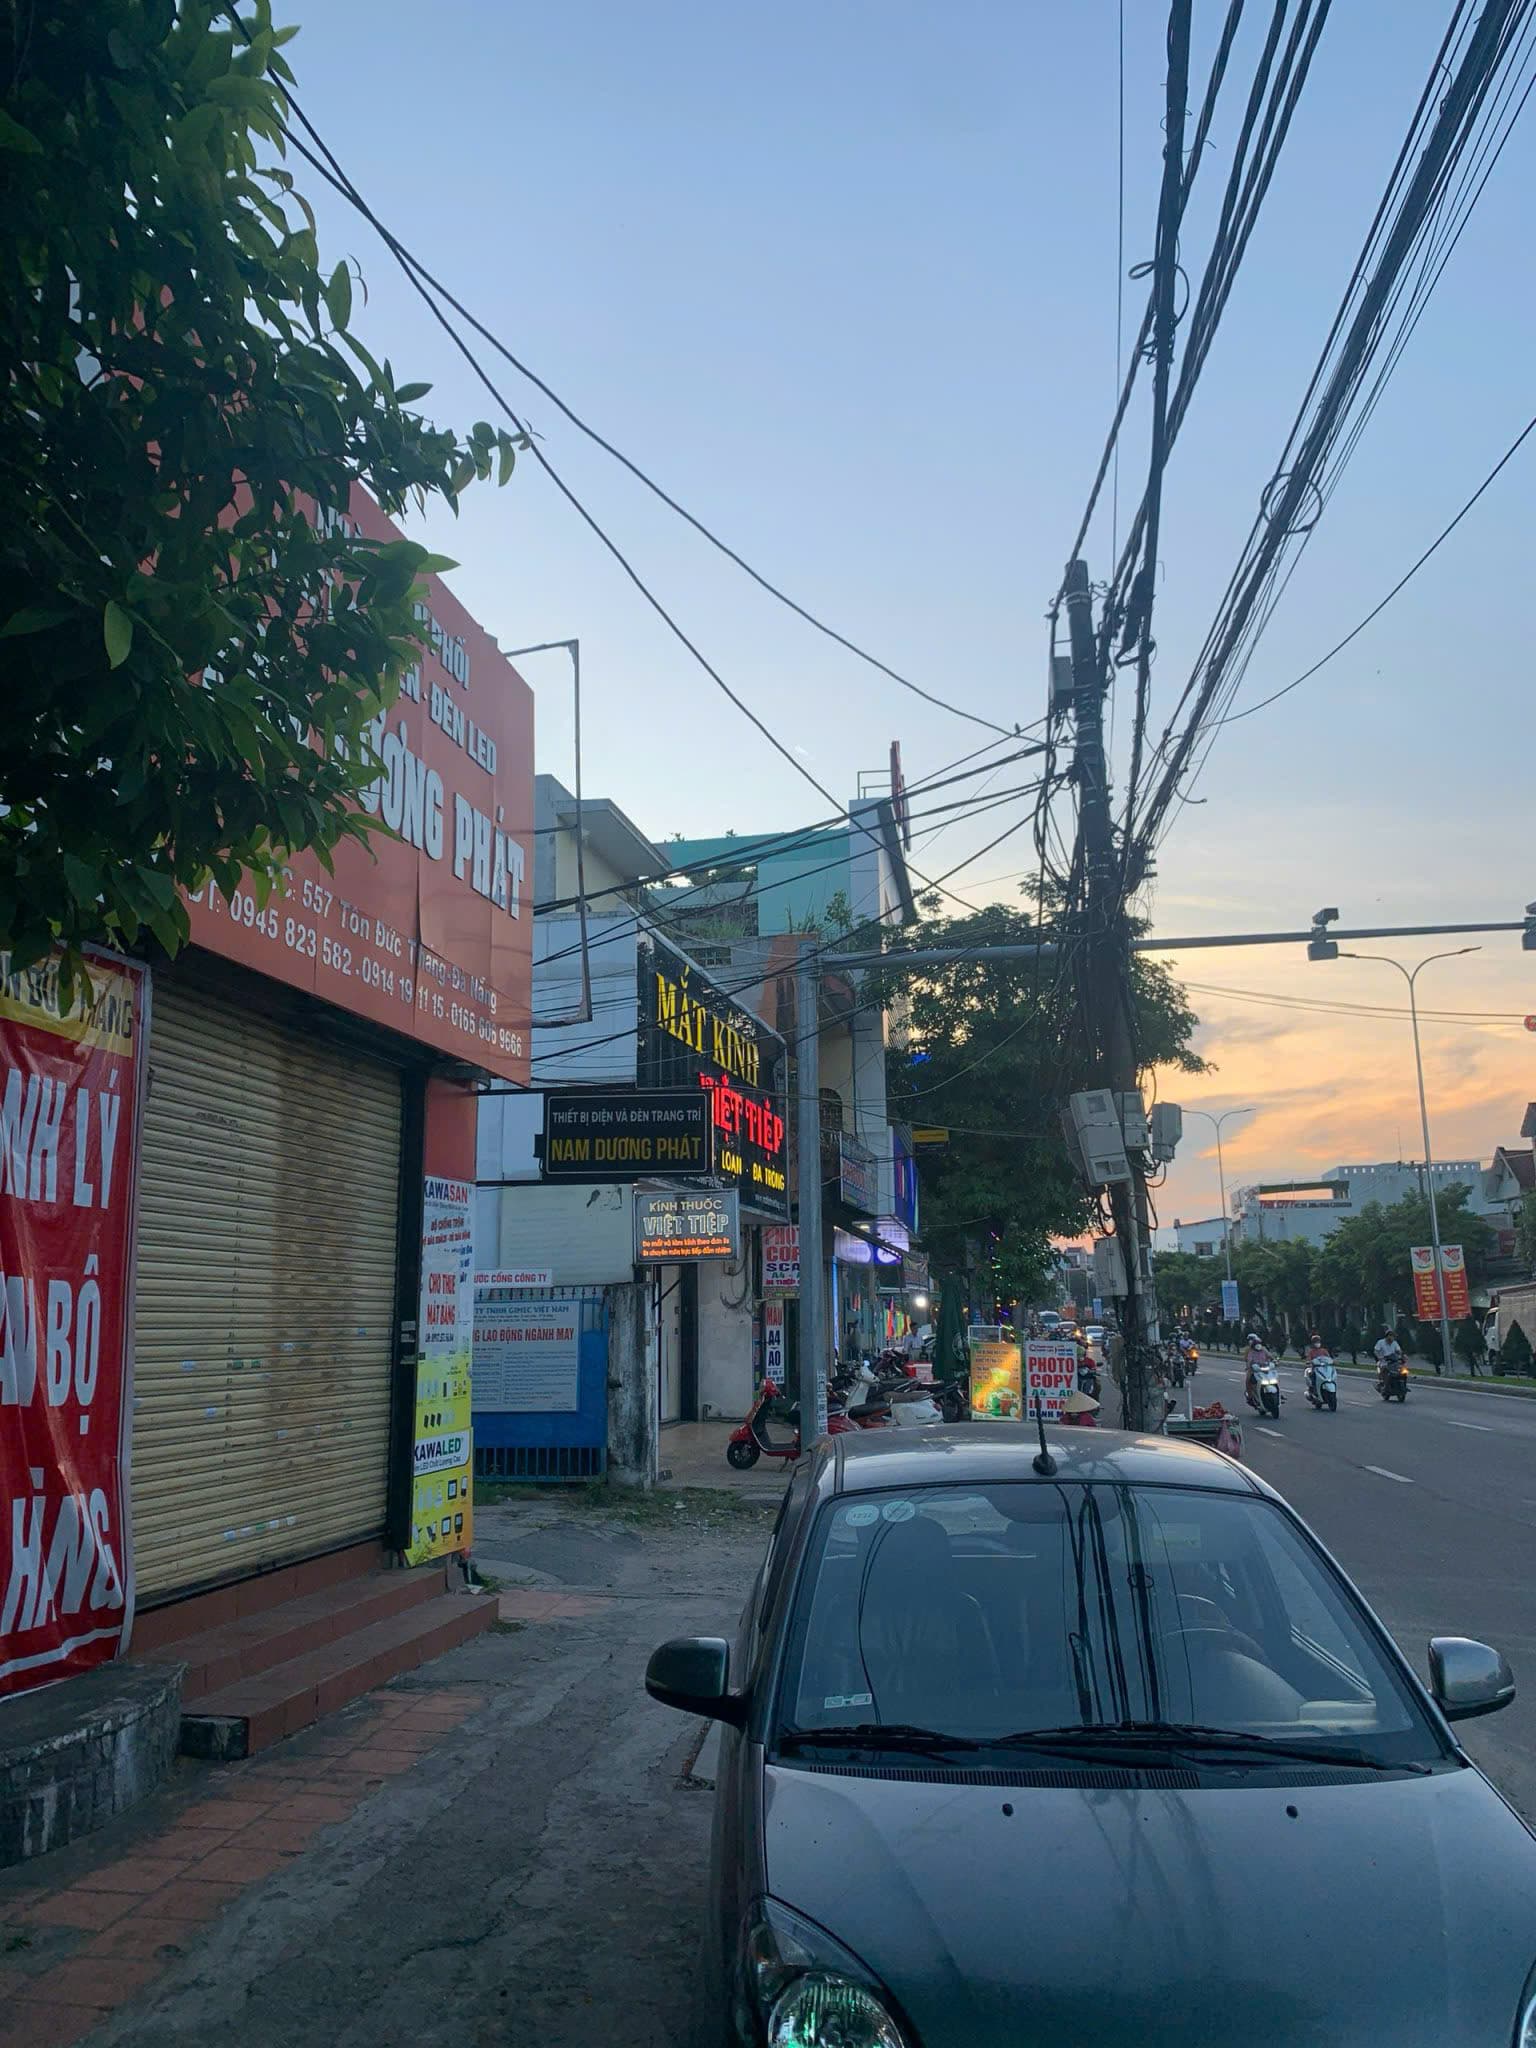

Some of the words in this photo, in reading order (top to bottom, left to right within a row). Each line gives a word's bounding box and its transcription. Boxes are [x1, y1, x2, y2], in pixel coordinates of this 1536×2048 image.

[430, 682, 465, 748] ĐÈN
[467, 719, 497, 776] LED
[453, 790, 525, 920] PHÁT
[302, 878, 334, 919] 557
[340, 898, 370, 941] Tôn
[375, 919, 401, 958] Đức
[230, 889, 279, 940] 0945
[285, 917, 317, 958] 823
[322, 936, 352, 977] 582
[362, 955, 395, 997] 0914
[399, 977, 413, 1004] 19
[417, 985, 429, 1013] 11
[431, 993, 445, 1019] 15
[656, 964, 706, 1055] MẮT
[712, 1010, 760, 1088] KÍNH
[553, 1107, 579, 1123] THIẾT
[580, 1110, 589, 1126] BỊ
[591, 1107, 613, 1126] ĐIỆN
[616, 1108, 628, 1122] VÀ
[630, 1108, 650, 1122] ĐÈN
[652, 1109, 685, 1121] TRANG
[687, 1107, 701, 1121] TRÍ
[745, 1096, 785, 1161] TIỆP
[73, 1068, 120, 1210] LÝ
[551, 1138, 589, 1161] NAM
[595, 1137, 651, 1160] DƯƠNG
[656, 1133, 701, 1159] PHÁT
[649, 1200, 677, 1212] KÍNH
[680, 1197, 722, 1210] THUỐC
[643, 1213, 685, 1238] VIỆT
[688, 1211, 729, 1236] TIỆP
[538, 1273, 547, 1282] TY
[47, 1254, 101, 1435] BỘ
[482, 1330, 498, 1342] LAO
[525, 1325, 555, 1342] NGÀNH
[557, 1327, 575, 1341] MAY
[768, 1329, 781, 1346] A4
[1028, 1356, 1075, 1373] PHOTO
[1030, 1373, 1073, 1388] COPY
